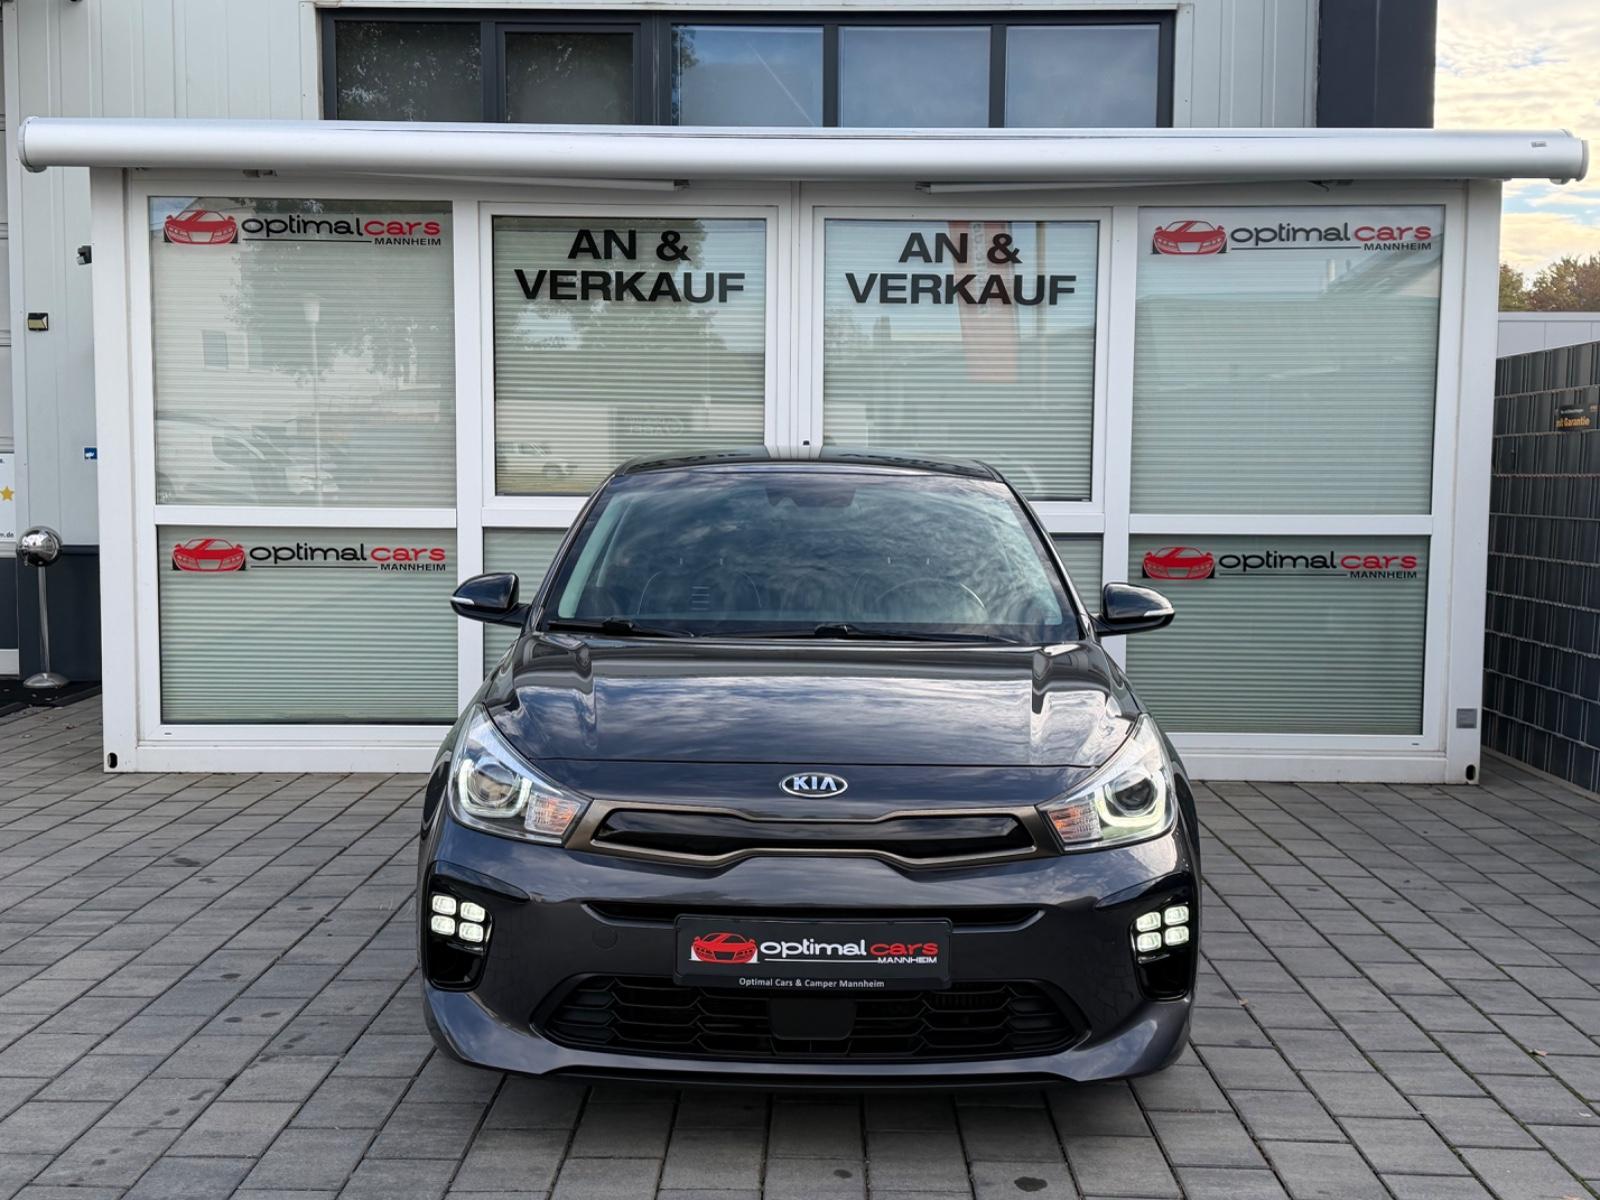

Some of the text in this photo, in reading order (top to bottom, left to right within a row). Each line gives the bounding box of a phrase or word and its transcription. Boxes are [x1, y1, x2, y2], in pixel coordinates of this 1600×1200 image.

[374, 237, 442, 246] MANNHEIM
[567, 229, 692, 261] AN &
[1363, 243, 1432, 251] MANNHEIM
[898, 232, 1023, 264] AN &
[514, 269, 746, 303] VERKAUF
[845, 273, 1077, 305] VERKAUF
[380, 563, 447, 571] MANNHEIM
[1349, 571, 1418, 579] MANNHEIM
[793, 776, 838, 791] KIA
[877, 956, 938, 964] MANNHEIM
[739, 977, 885, 989] Optimal Cars & Camper Mannheim
